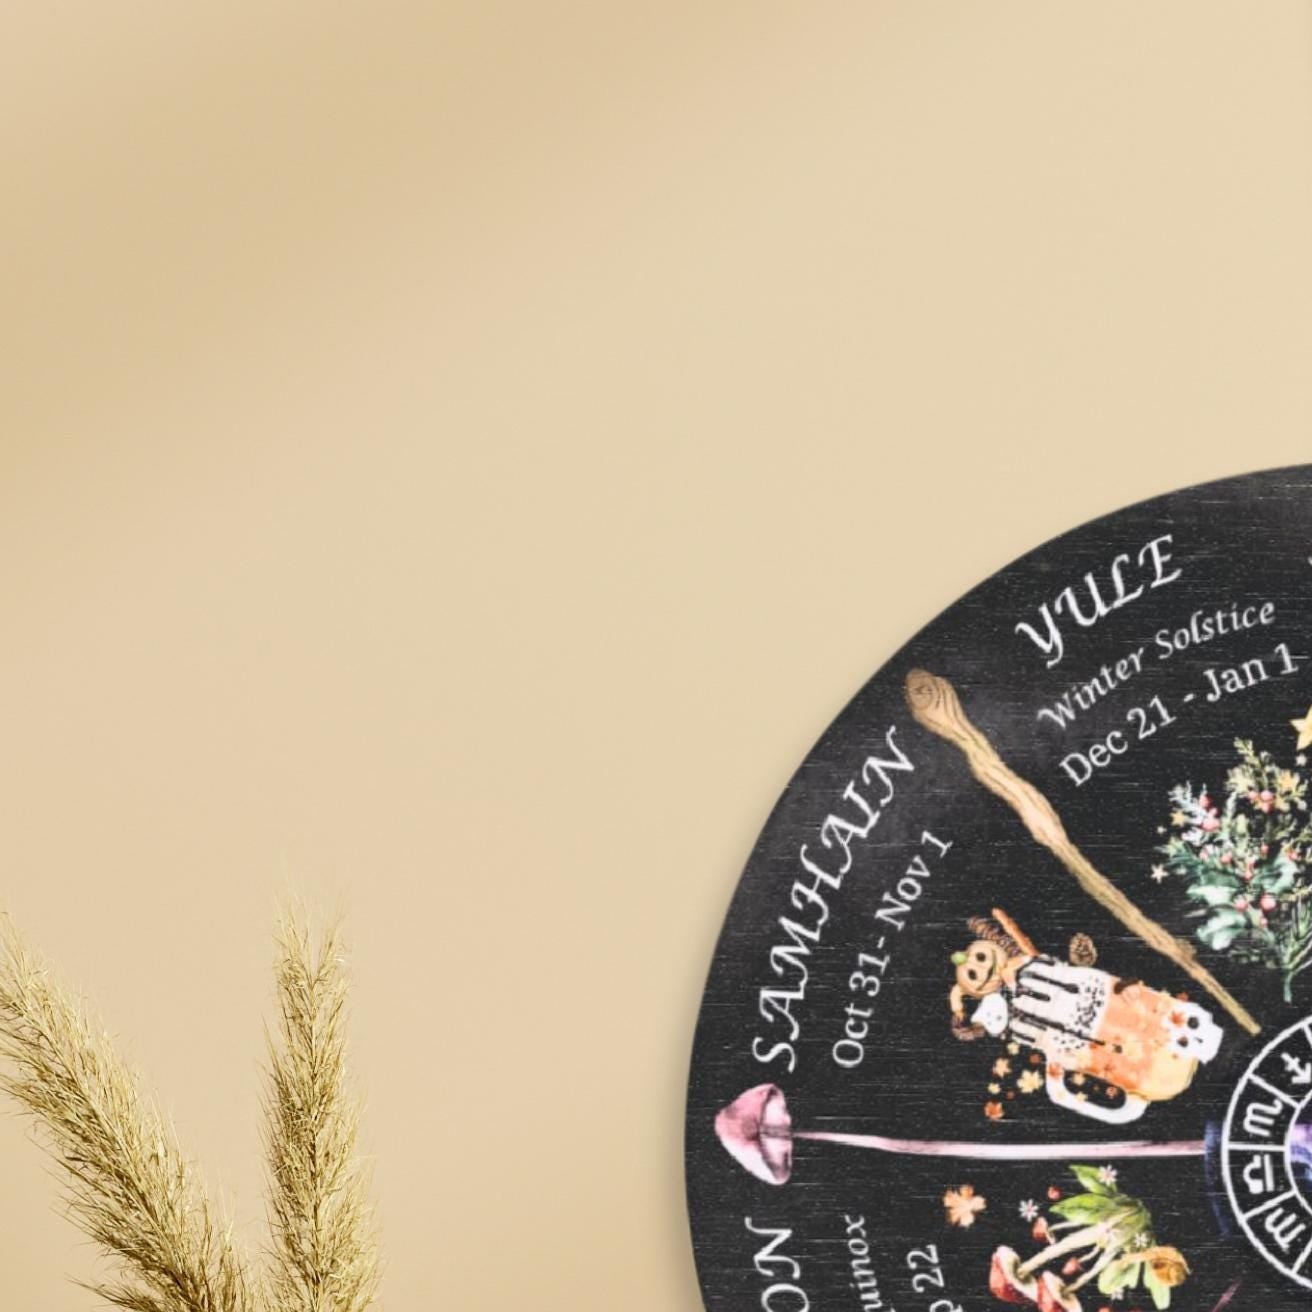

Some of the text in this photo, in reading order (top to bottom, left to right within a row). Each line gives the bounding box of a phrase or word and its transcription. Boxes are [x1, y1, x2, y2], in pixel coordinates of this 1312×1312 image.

[1015, 534, 1182, 668] YULE
[1037, 601, 1275, 730] Winter Solstice
[1059, 730, 1128, 787] Dec
[1126, 696, 1177, 739] 21
[1203, 658, 1267, 702] Jan
[1274, 642, 1299, 675] 1
[752, 726, 915, 1073] SAMHAIN
[832, 1002, 874, 1068] Oct
[874, 855, 931, 931] Nov
[921, 830, 953, 857] 1
[906, 1244, 944, 1292] 22
